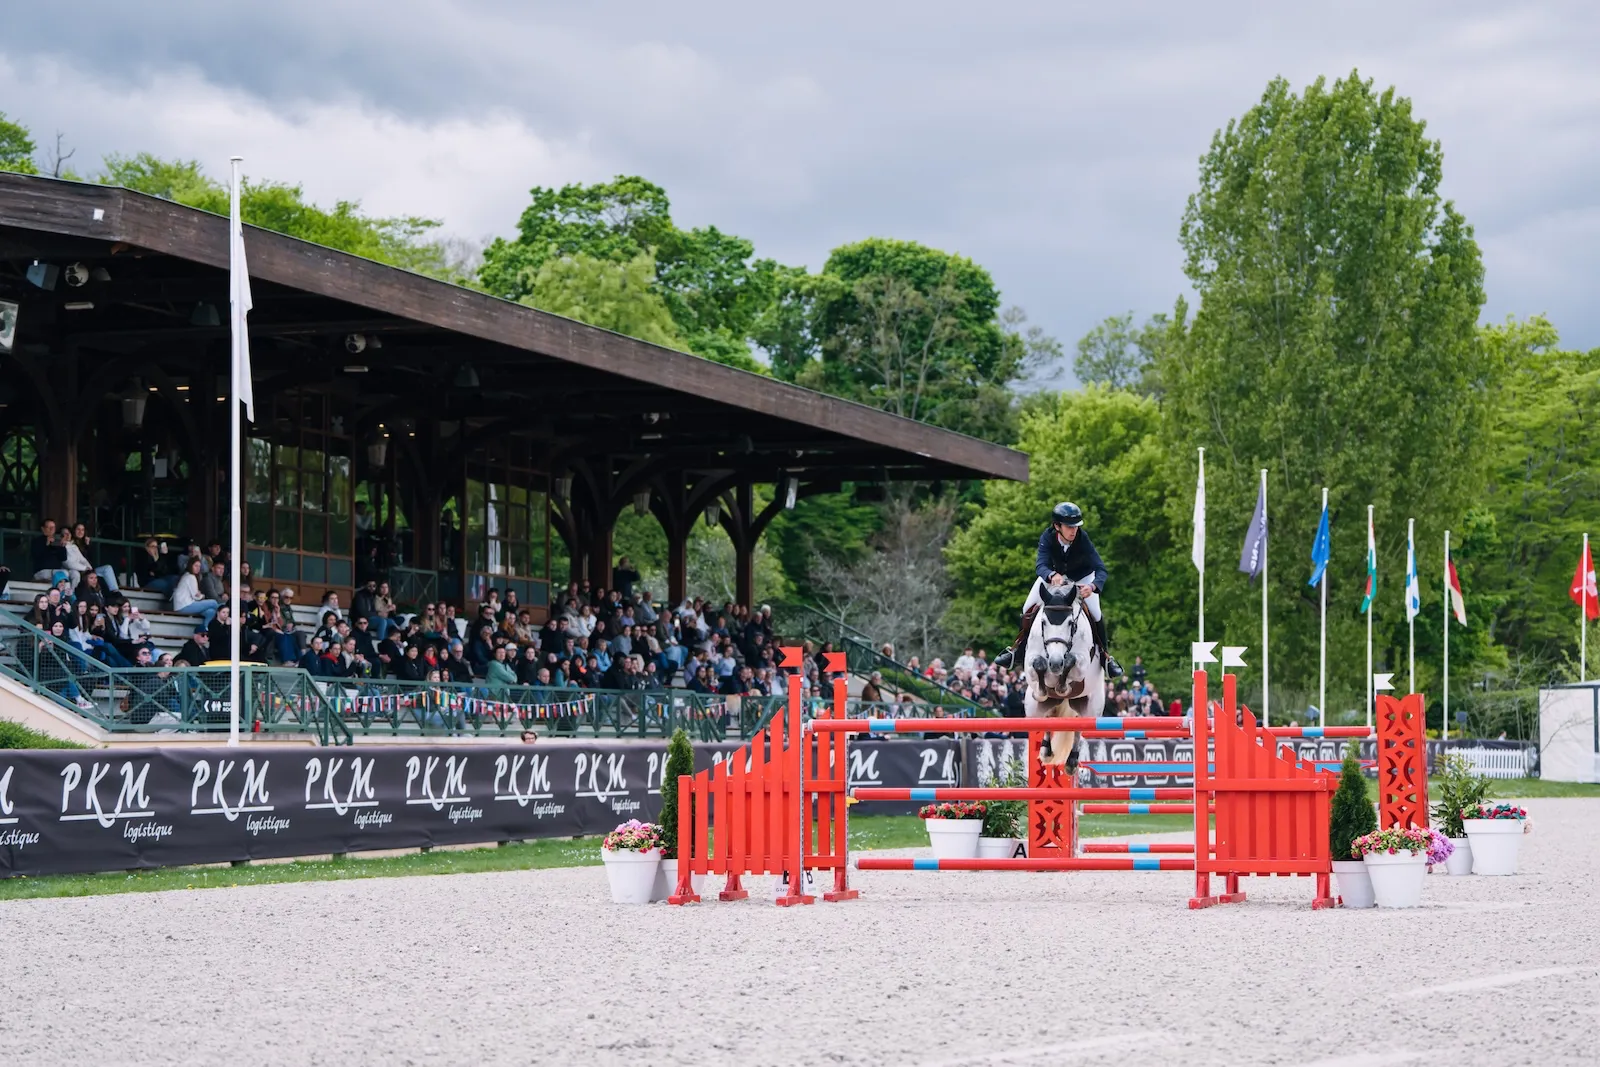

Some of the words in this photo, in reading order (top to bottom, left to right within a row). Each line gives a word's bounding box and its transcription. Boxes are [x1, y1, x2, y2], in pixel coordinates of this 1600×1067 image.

[405, 755, 468, 811] PKM
[494, 754, 550, 807] PKM
[574, 753, 627, 803] PKM
[647, 752, 672, 788] PK
[919, 748, 955, 788] PK
[60, 761, 151, 829] PKM
[191, 758, 270, 822] PKM
[305, 756, 375, 816] PKM
[353, 809, 393, 830] logistique
[448, 804, 483, 825] logistique
[533, 801, 565, 820] logistique
[611, 797, 641, 815] logistique
[0, 828, 40, 850] istique
[123, 820, 173, 844] logistique
[246, 814, 290, 836] logistique
[1012, 843, 1027, 858] A
